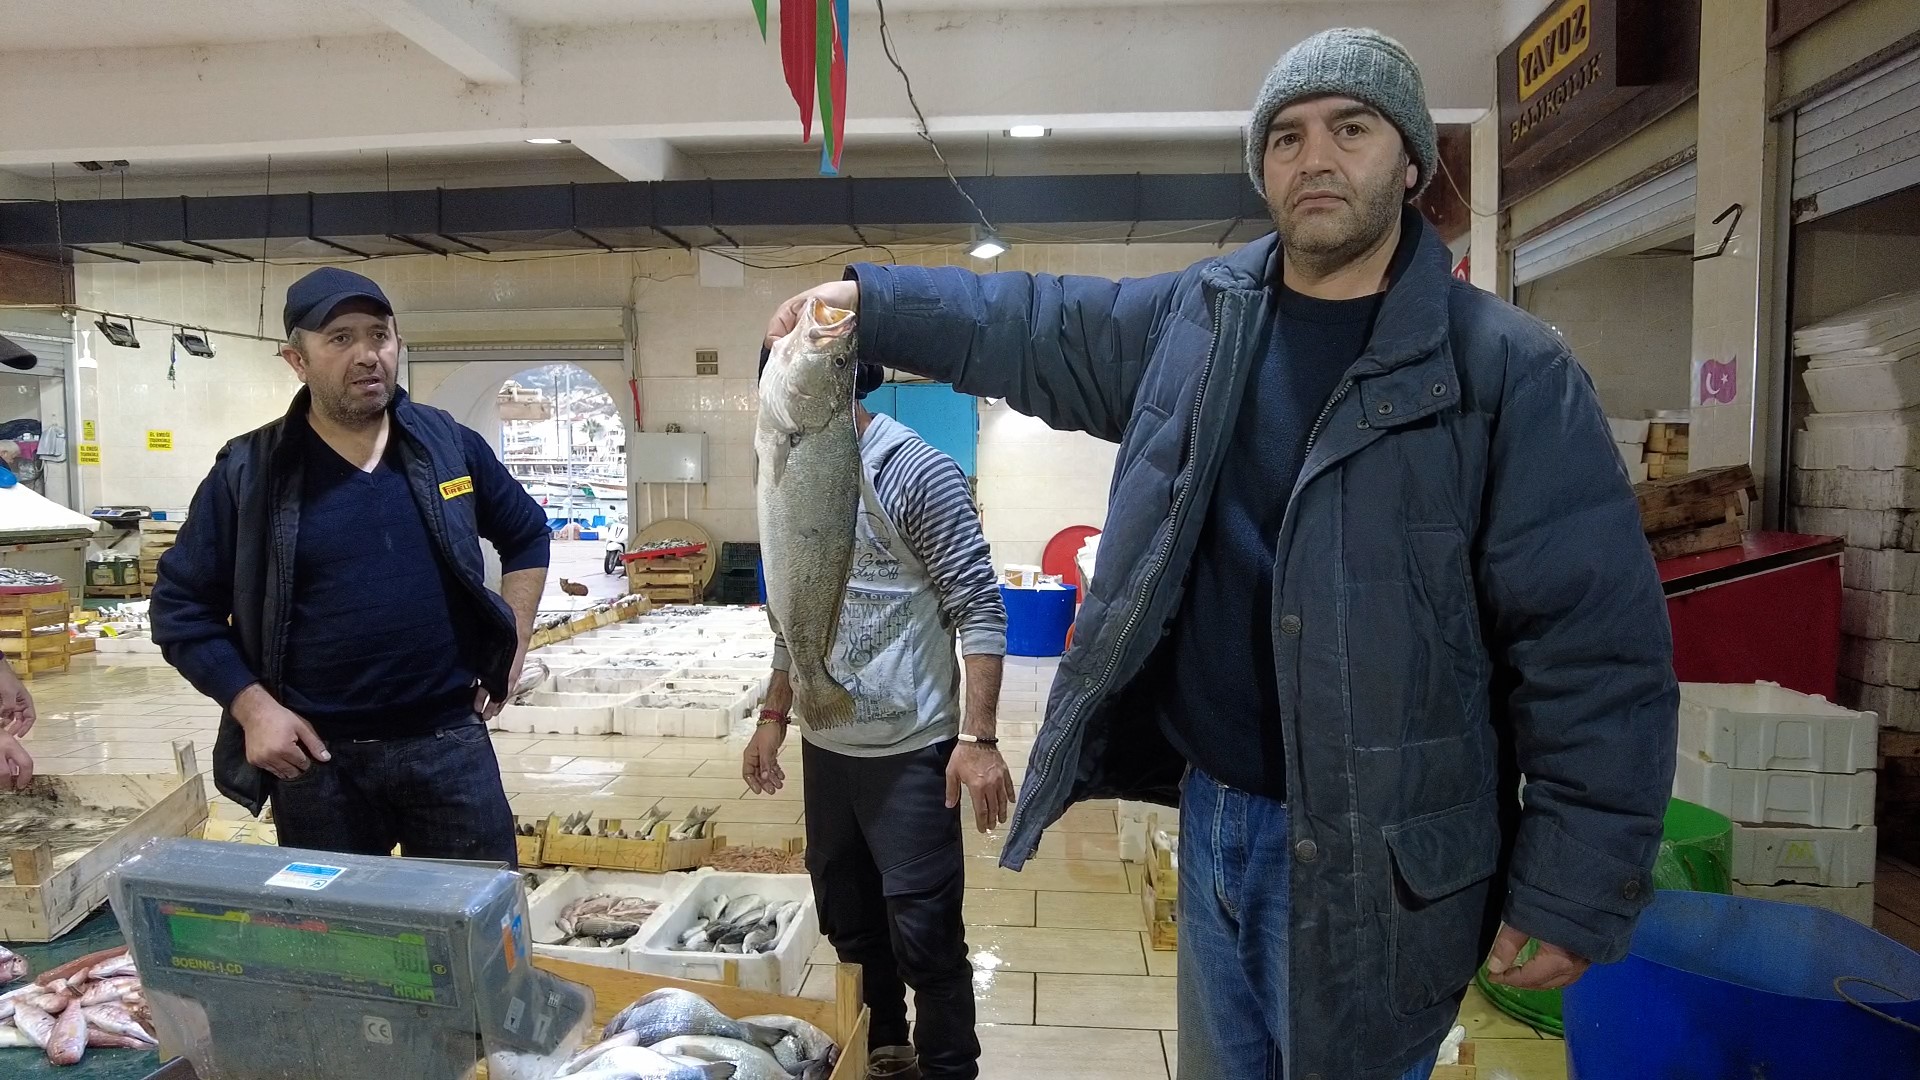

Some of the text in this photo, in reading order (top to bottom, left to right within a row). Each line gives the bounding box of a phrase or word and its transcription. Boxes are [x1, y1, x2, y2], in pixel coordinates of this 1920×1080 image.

[1521, 4, 1587, 87] YAVUZ
[1510, 52, 1602, 143] BALIKÇILIK
[878, 566, 899, 580] Off
[367, 1022, 390, 1039] CE
